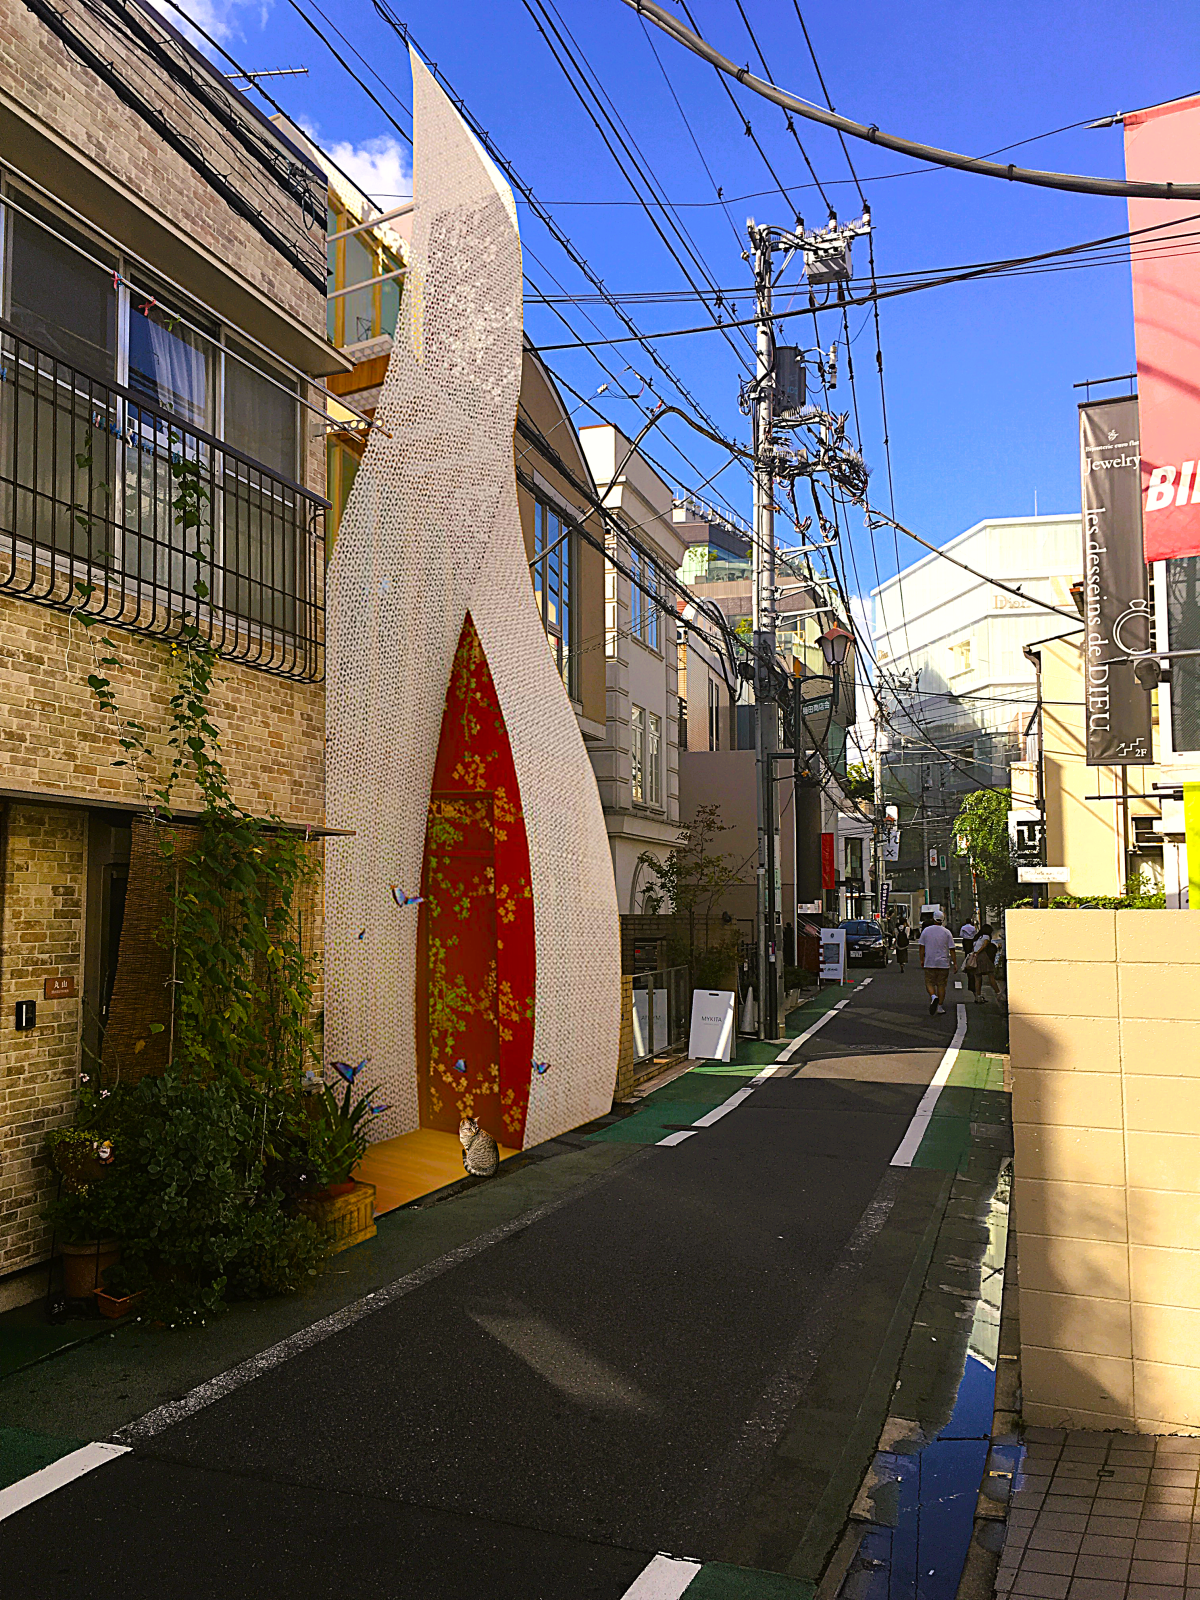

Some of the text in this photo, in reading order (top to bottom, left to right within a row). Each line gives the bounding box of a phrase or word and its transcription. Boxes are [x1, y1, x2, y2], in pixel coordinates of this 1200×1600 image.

[1085, 454, 1141, 475] Jewelry
[993, 595, 1027, 610] Dior
[1086, 508, 1110, 731] les desseins de DIEU
[1135, 749, 1147, 757] 2F
